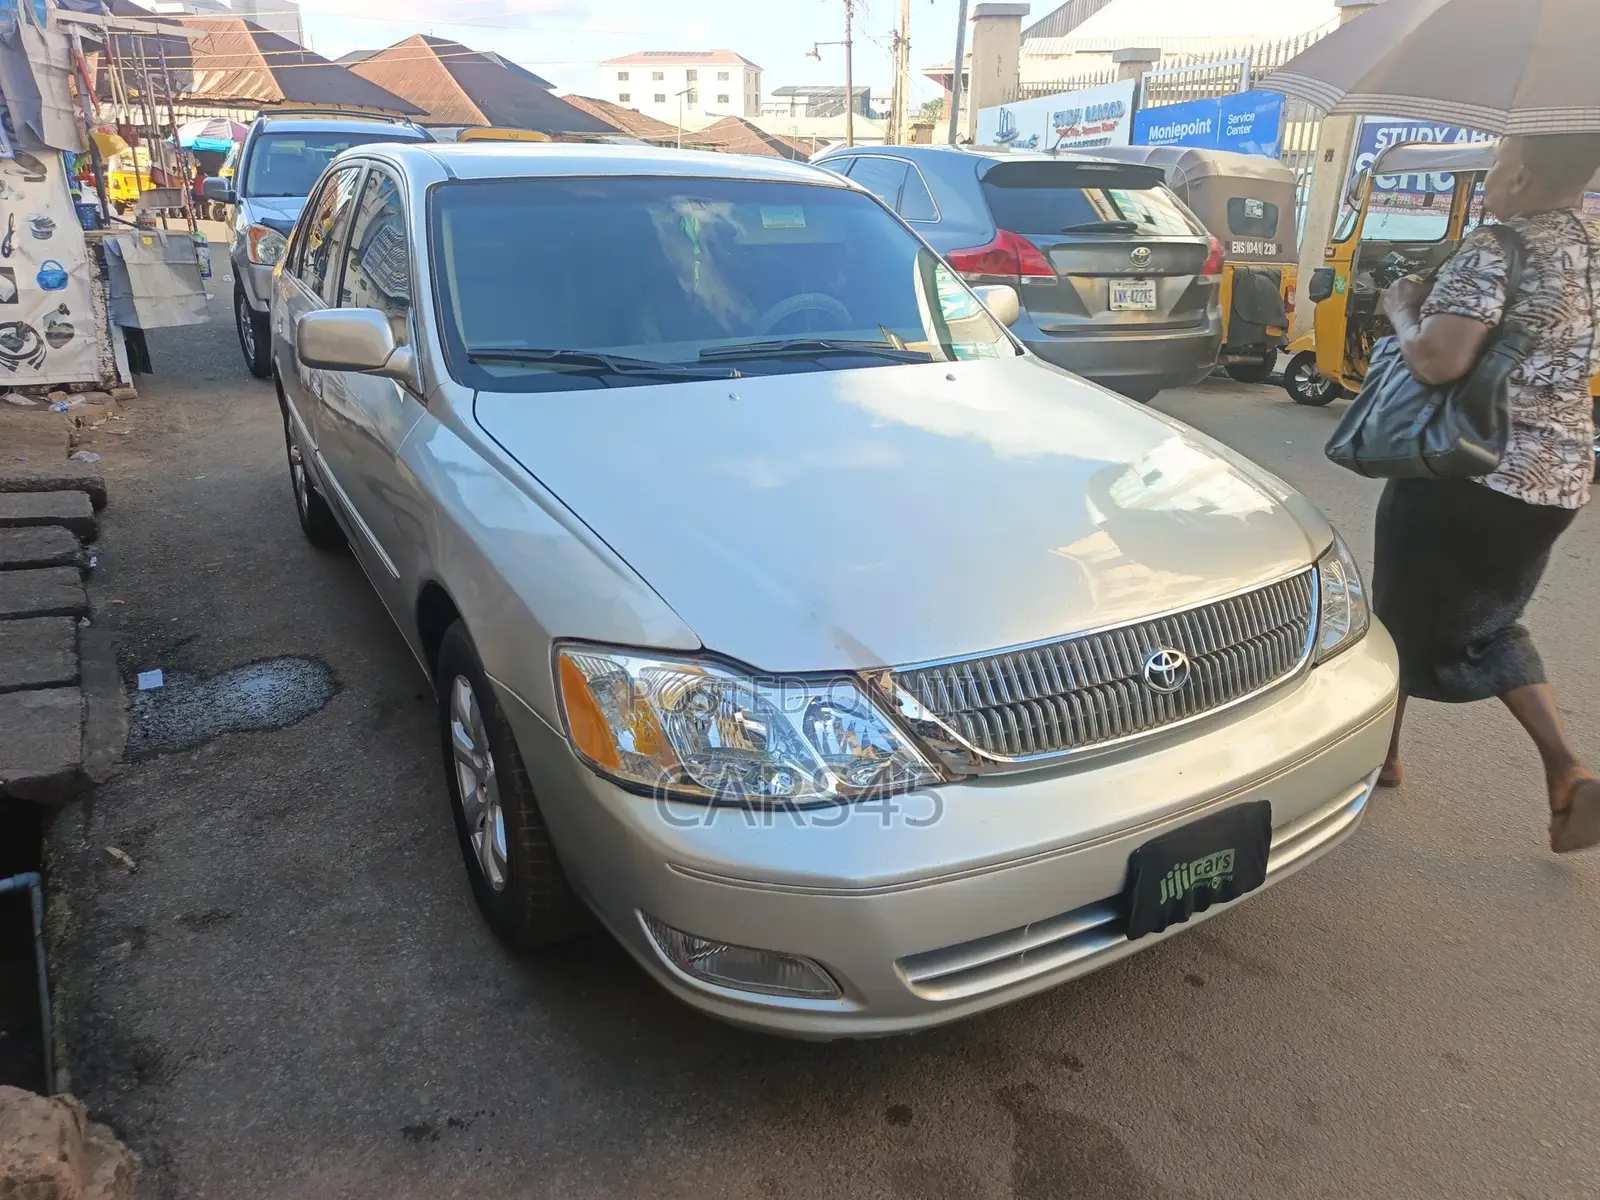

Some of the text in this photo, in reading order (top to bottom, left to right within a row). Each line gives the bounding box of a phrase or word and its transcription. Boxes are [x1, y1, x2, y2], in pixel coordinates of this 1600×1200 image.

[1228, 112, 1255, 124] Service
[1149, 118, 1212, 140] Moniepoint
[1227, 124, 1252, 136] Center
[1375, 127, 1449, 148] STUDY
